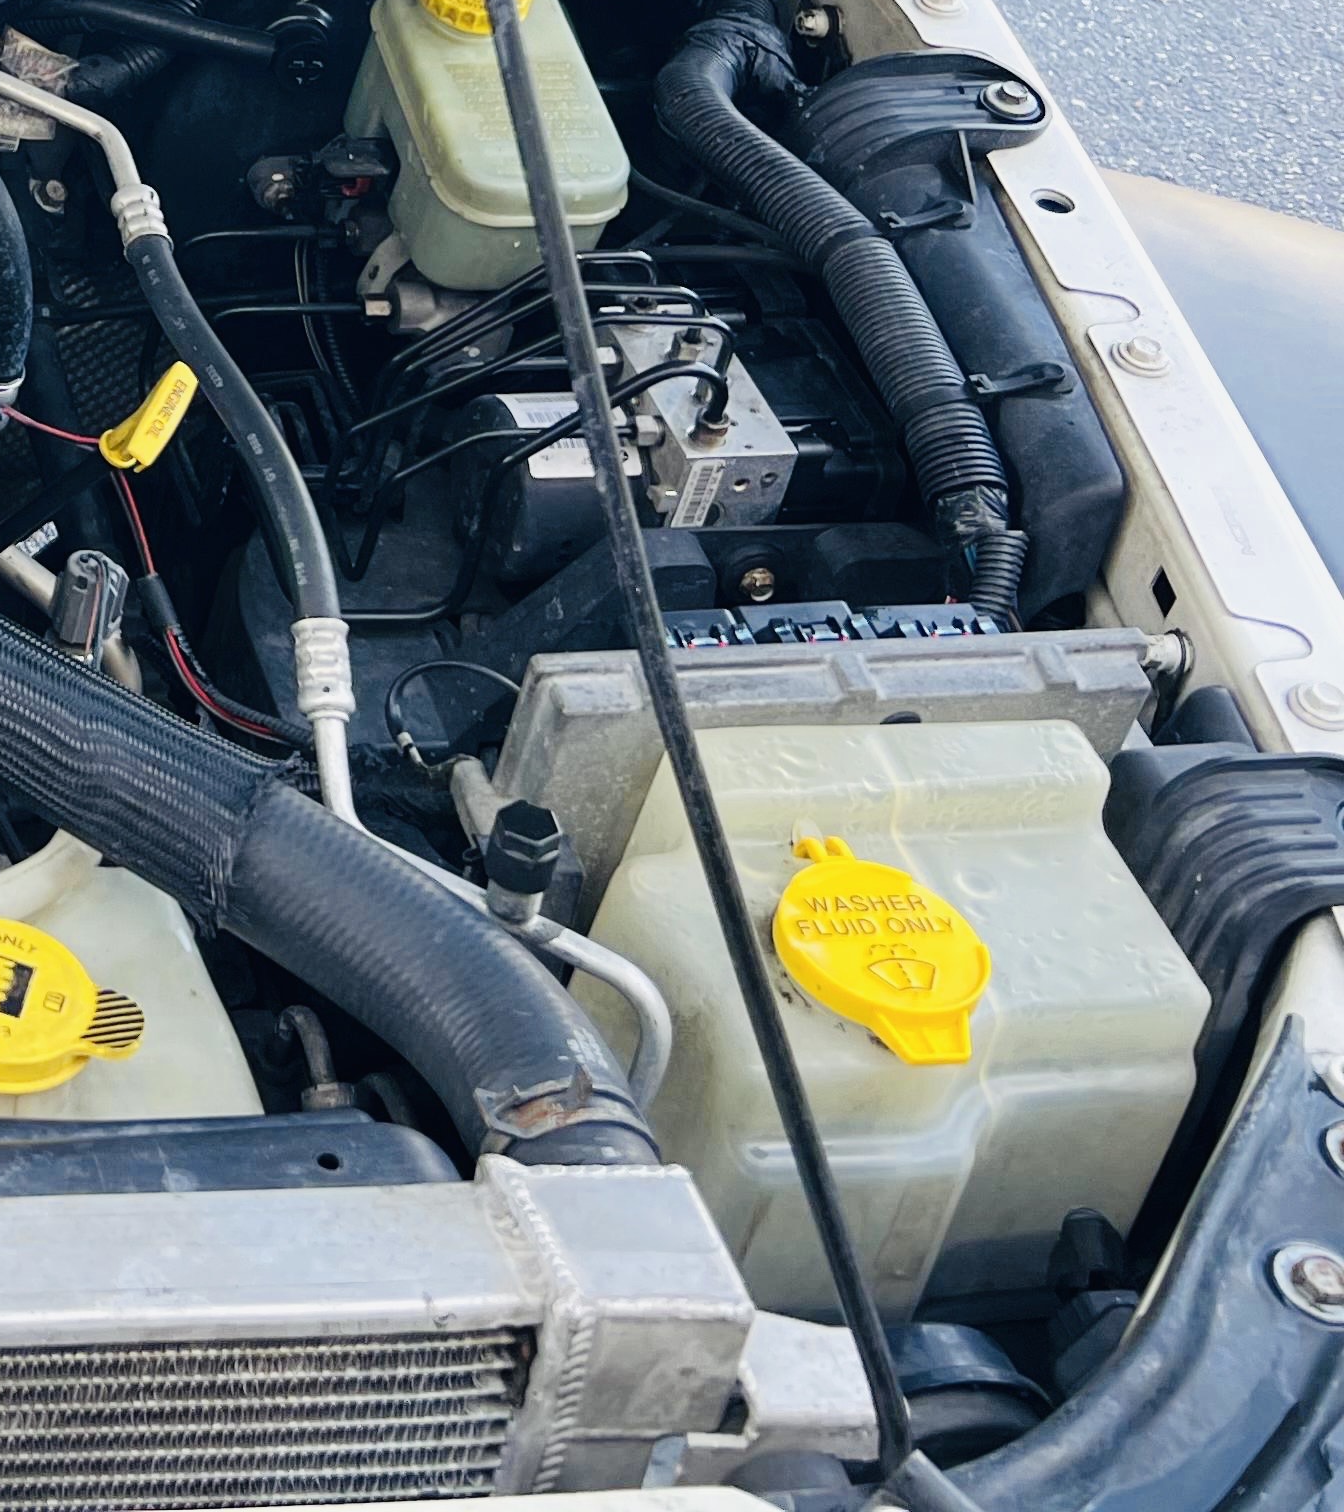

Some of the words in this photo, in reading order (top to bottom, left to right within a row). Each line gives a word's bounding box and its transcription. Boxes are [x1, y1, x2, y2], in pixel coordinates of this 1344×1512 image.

[158, 379, 188, 421] ENGINE
[146, 419, 165, 439] OIL
[804, 894, 928, 913] WASHER
[795, 917, 877, 937] FLUID
[886, 917, 956, 936] ONLY
